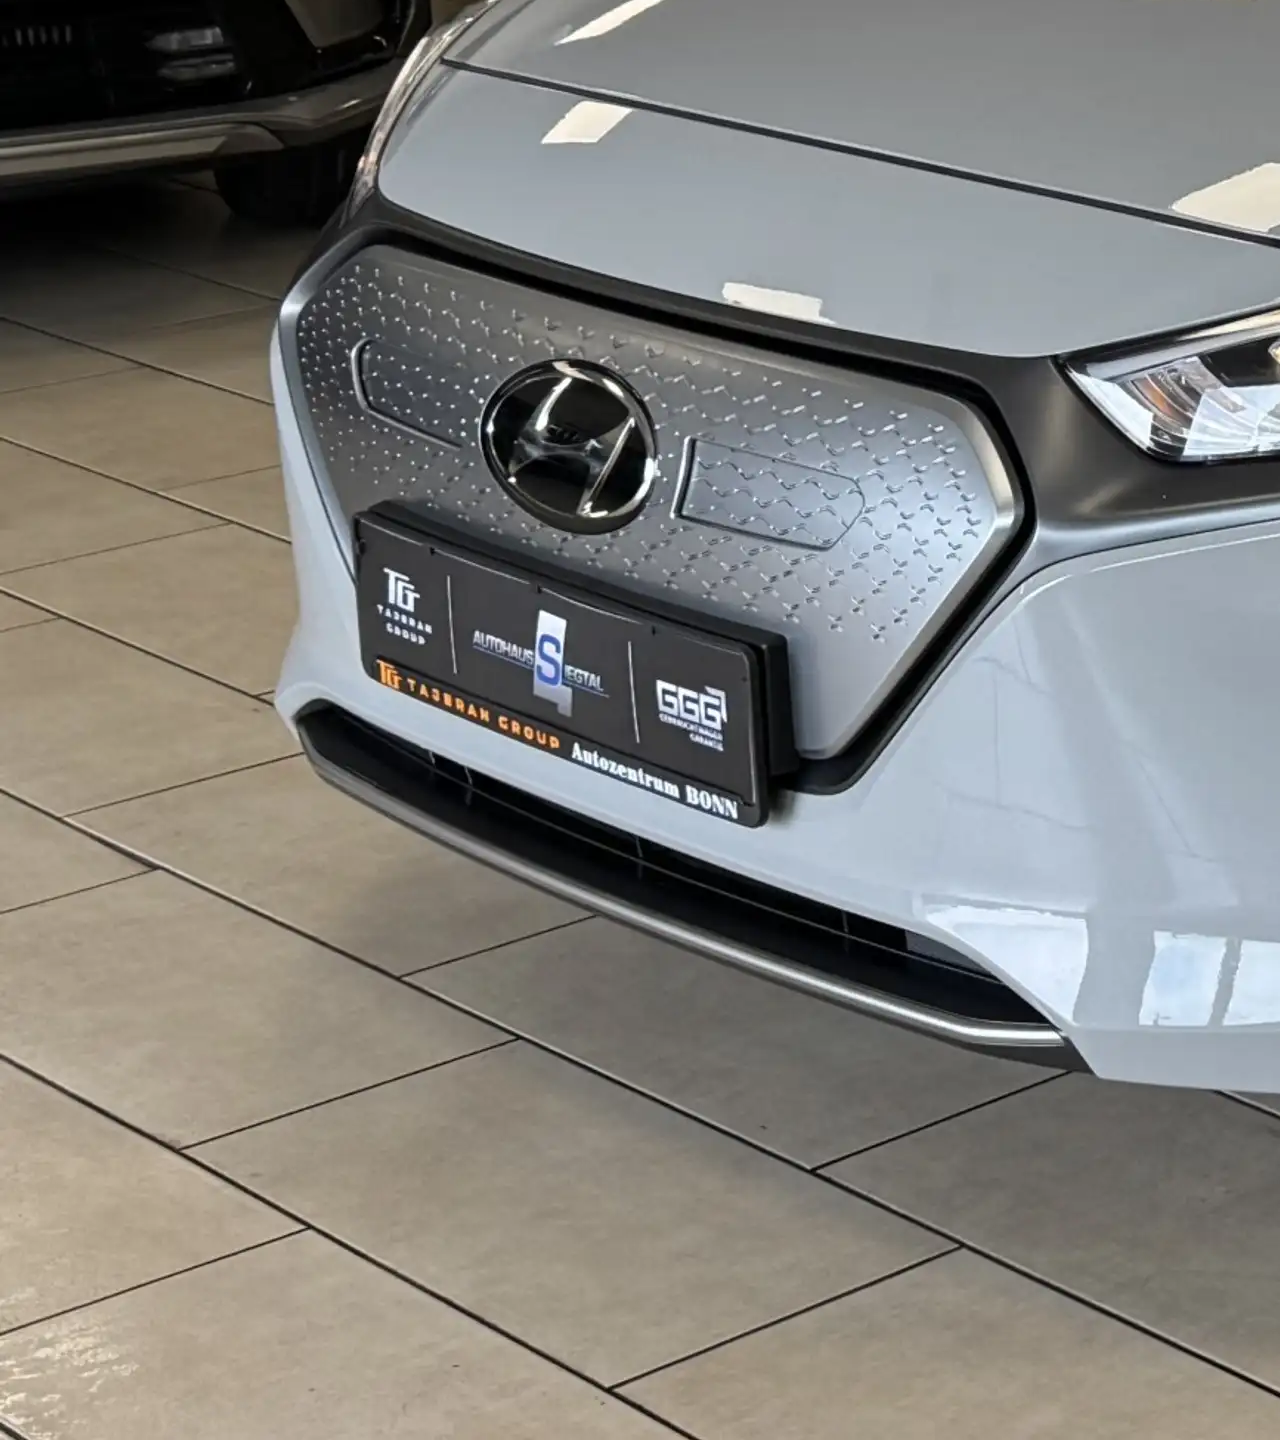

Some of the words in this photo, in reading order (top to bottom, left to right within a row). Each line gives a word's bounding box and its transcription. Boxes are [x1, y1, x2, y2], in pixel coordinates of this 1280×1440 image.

[386, 622, 426, 645] GROUP
[472, 629, 535, 665] AUTOHAUS
[497, 715, 561, 749] GROUP
[571, 741, 681, 799] Autozentrum
[685, 784, 739, 820] BONN
